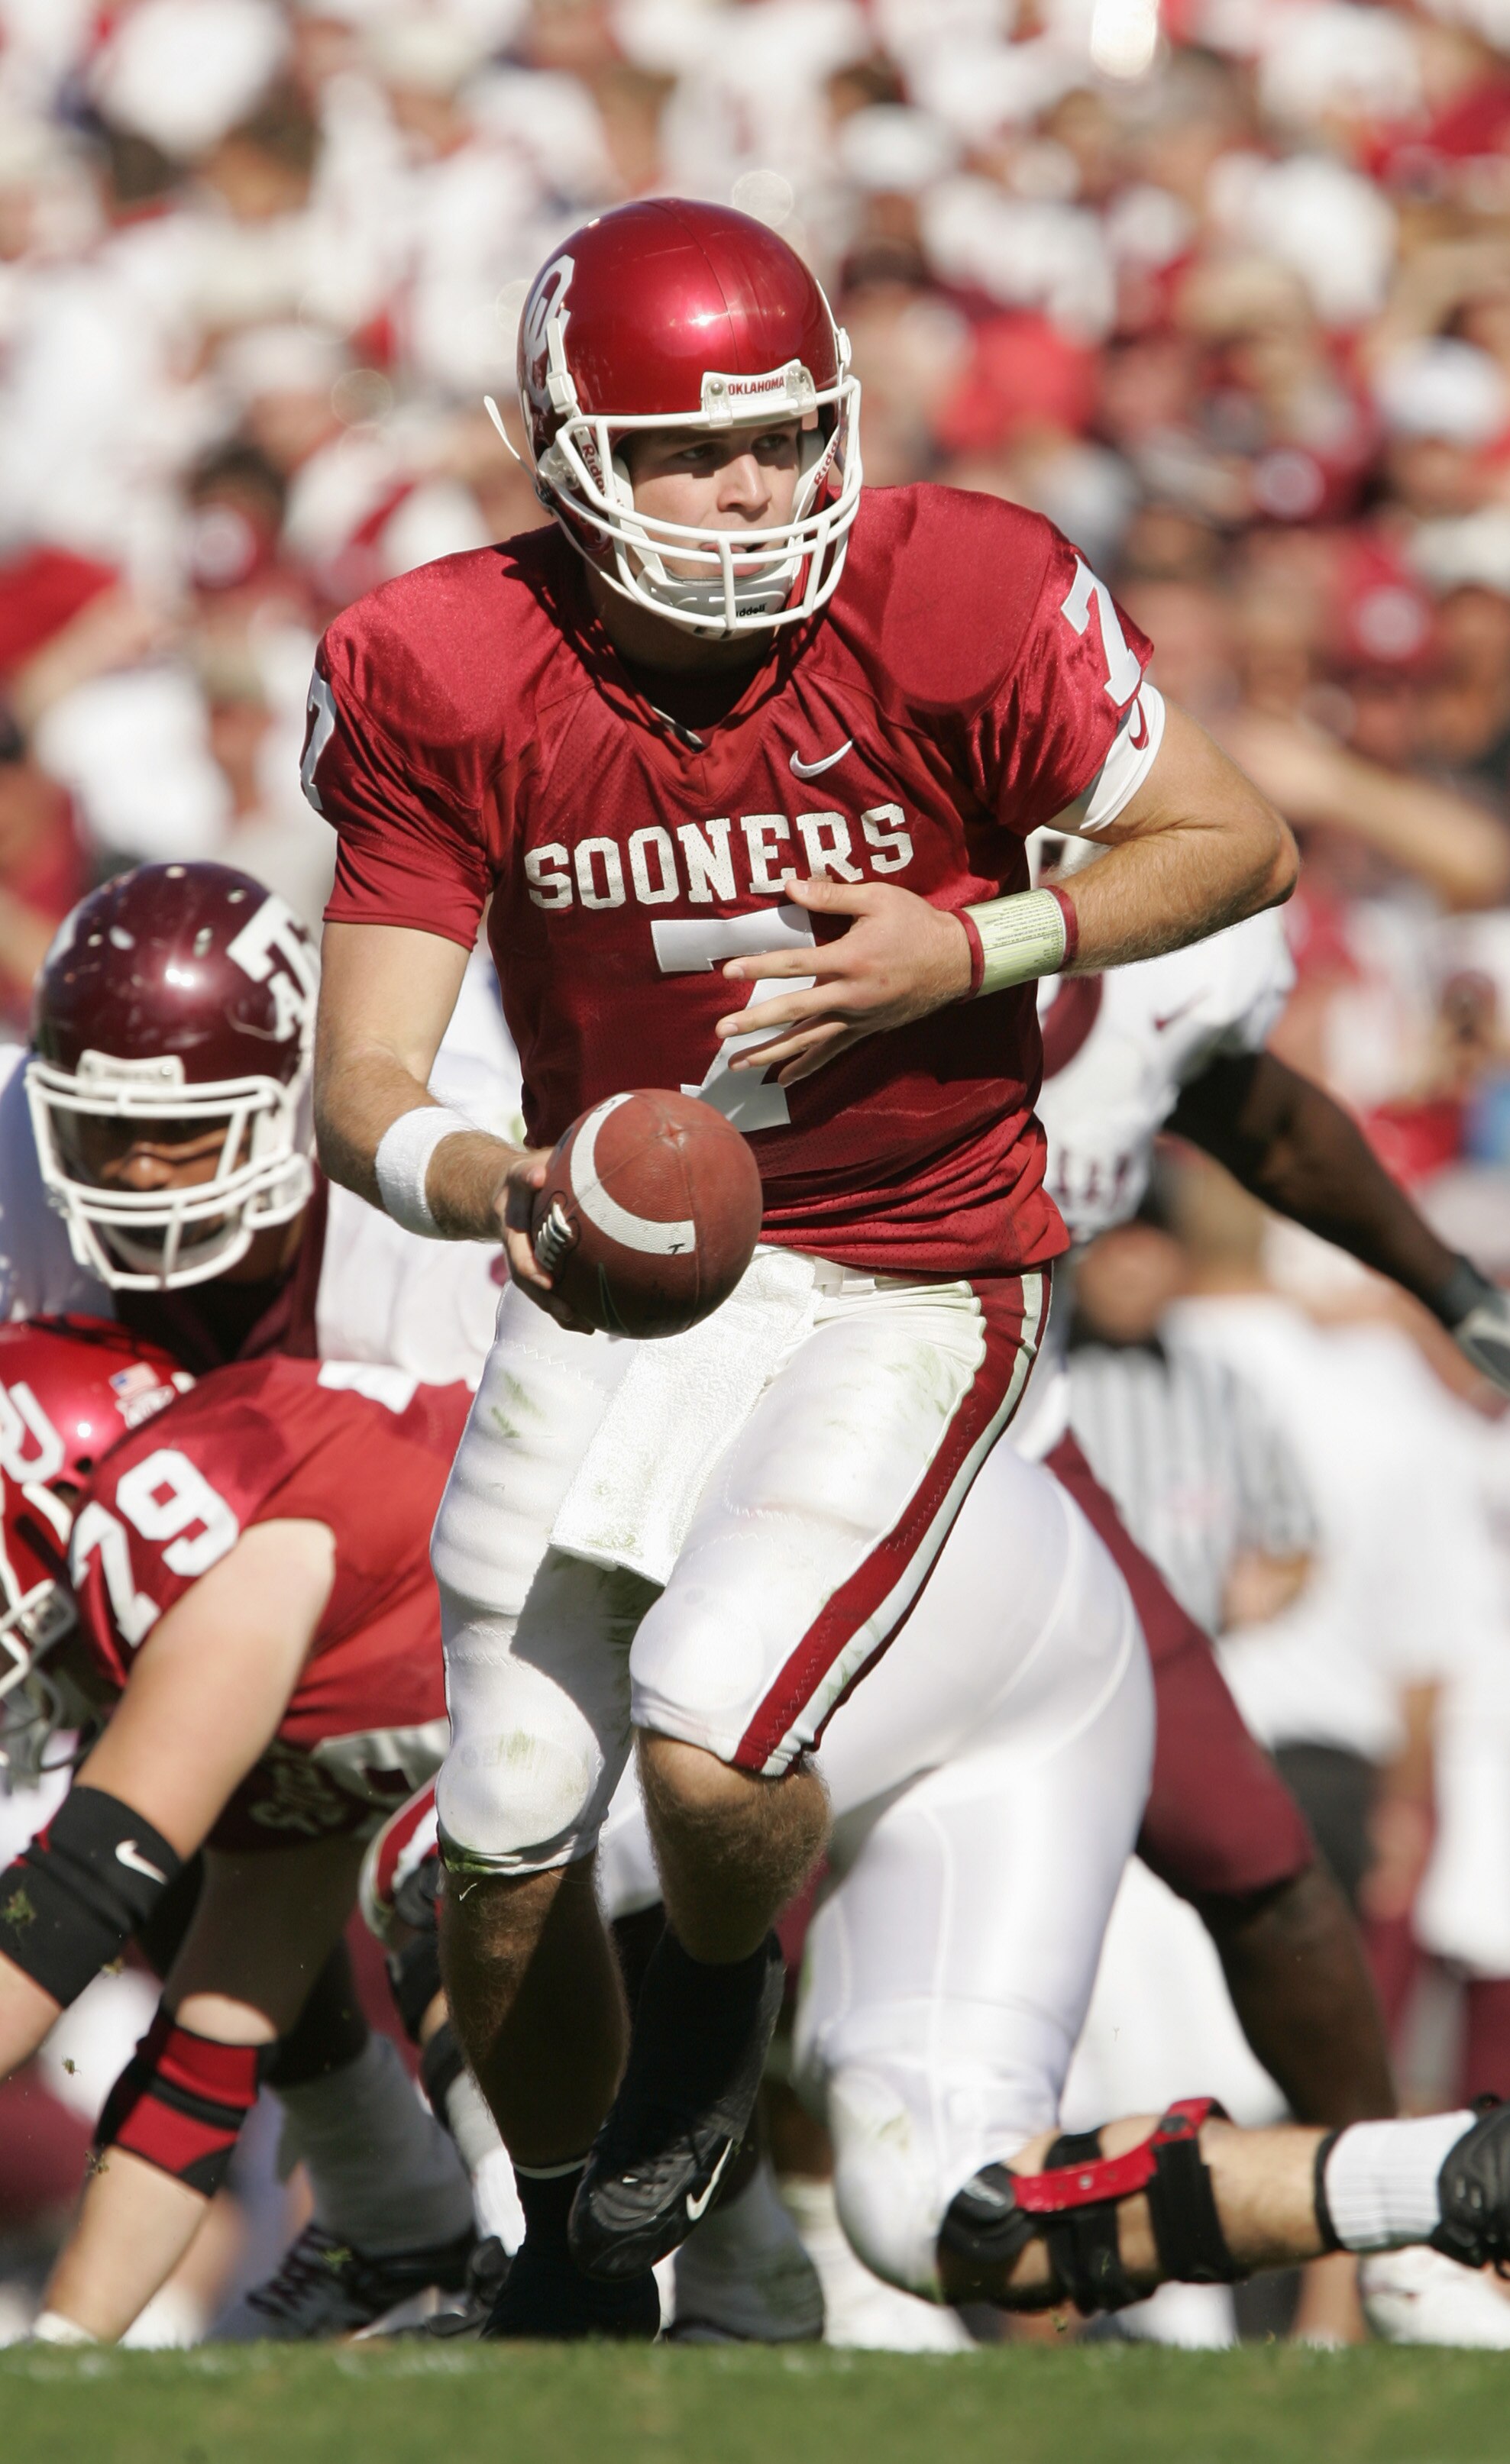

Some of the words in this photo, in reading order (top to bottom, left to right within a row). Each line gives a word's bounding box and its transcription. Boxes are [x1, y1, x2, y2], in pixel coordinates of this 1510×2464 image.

[728, 376, 785, 396] OKLAHOMA
[1061, 554, 1141, 706] 7
[524, 803, 913, 909] SOONERS
[651, 904, 816, 1132] 7
[70, 1448, 239, 1648] 79
